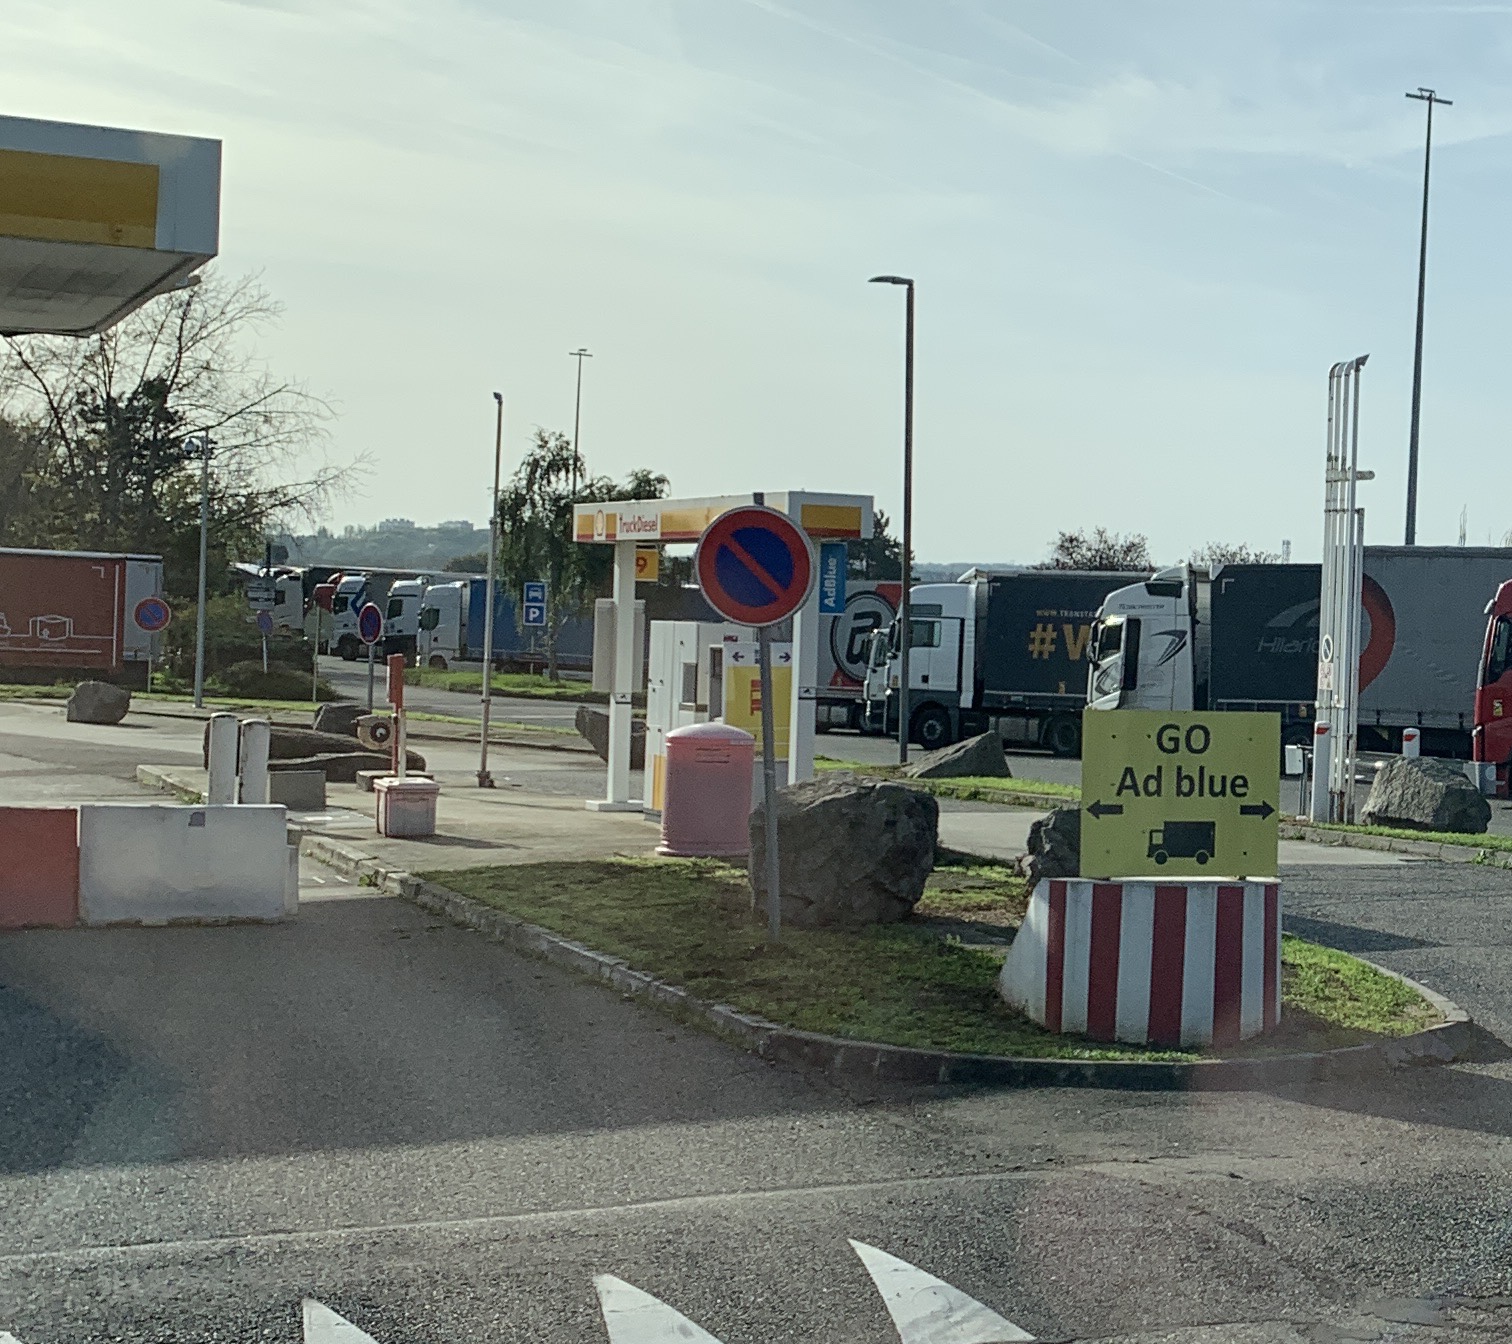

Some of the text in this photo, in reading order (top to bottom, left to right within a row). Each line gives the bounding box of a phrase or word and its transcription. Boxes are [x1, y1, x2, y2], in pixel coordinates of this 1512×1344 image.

[618, 513, 658, 533] TruckDiesel
[824, 556, 837, 608] AdBlue
[529, 607, 540, 621] P
[1156, 723, 1211, 754] GO
[1116, 765, 1250, 798] Ad blue
